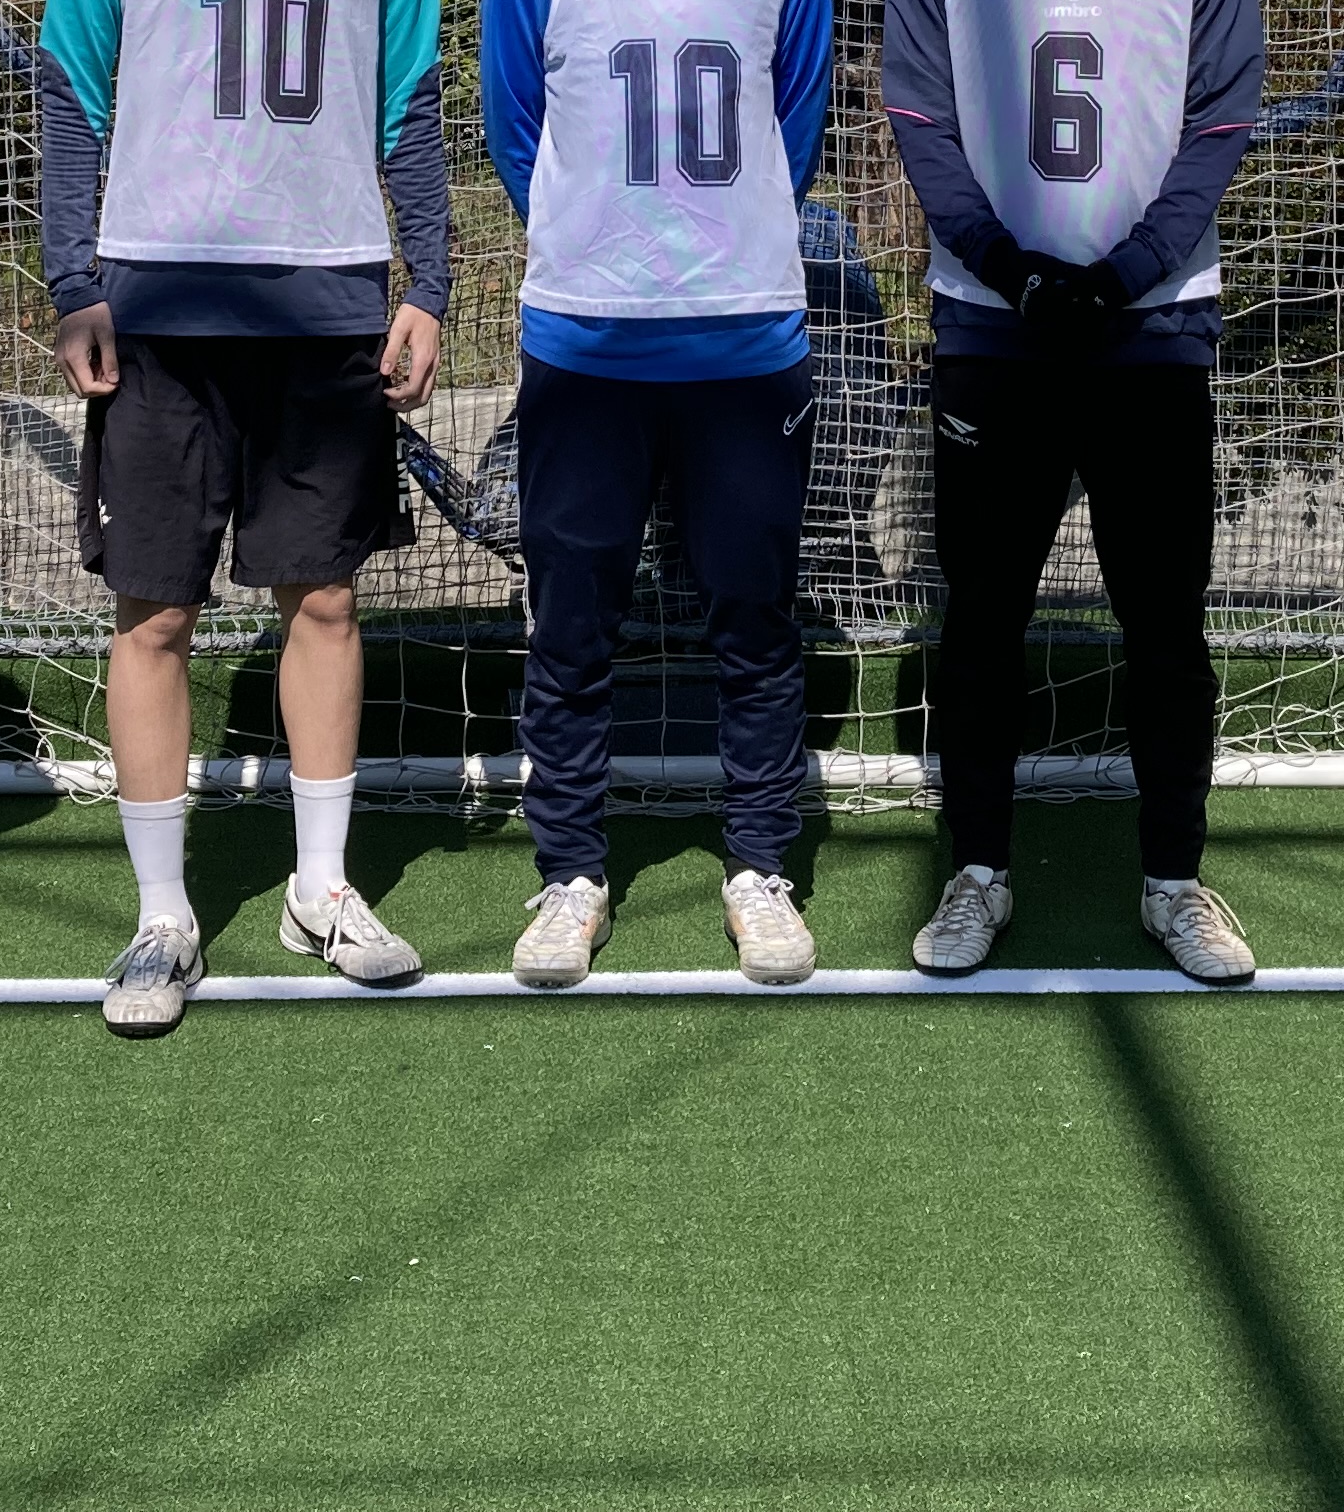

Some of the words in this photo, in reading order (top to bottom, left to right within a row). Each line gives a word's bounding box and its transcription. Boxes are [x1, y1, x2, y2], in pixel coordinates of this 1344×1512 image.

[1044, 2, 1103, 18] umbro
[608, 38, 742, 187] 10
[1029, 31, 1103, 183] 6
